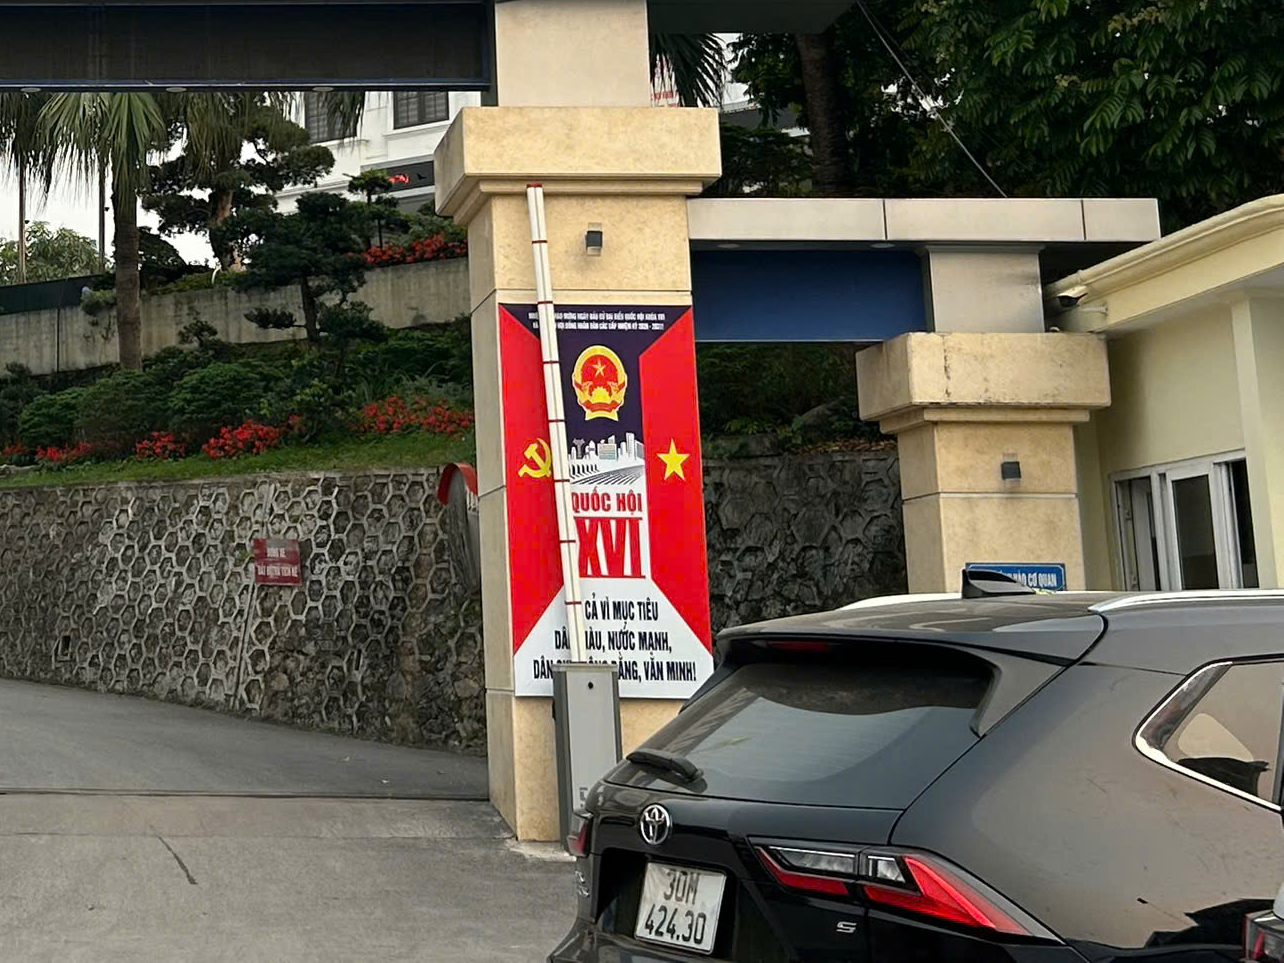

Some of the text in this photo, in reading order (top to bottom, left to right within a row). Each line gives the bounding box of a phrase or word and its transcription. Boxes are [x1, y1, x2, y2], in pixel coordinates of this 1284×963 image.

[572, 486, 643, 515] QUỐC HỘI
[573, 516, 646, 579] XVI
[585, 592, 598, 620] CẢ
[600, 596, 611, 620] VÌ
[637, 597, 659, 621] TIÊU
[554, 626, 570, 650] DÂ
[585, 627, 606, 653] IÀU,
[613, 651, 642, 682] ẰNG,
[667, 661, 697, 682] MINH!
[645, 904, 707, 945] 424.30
